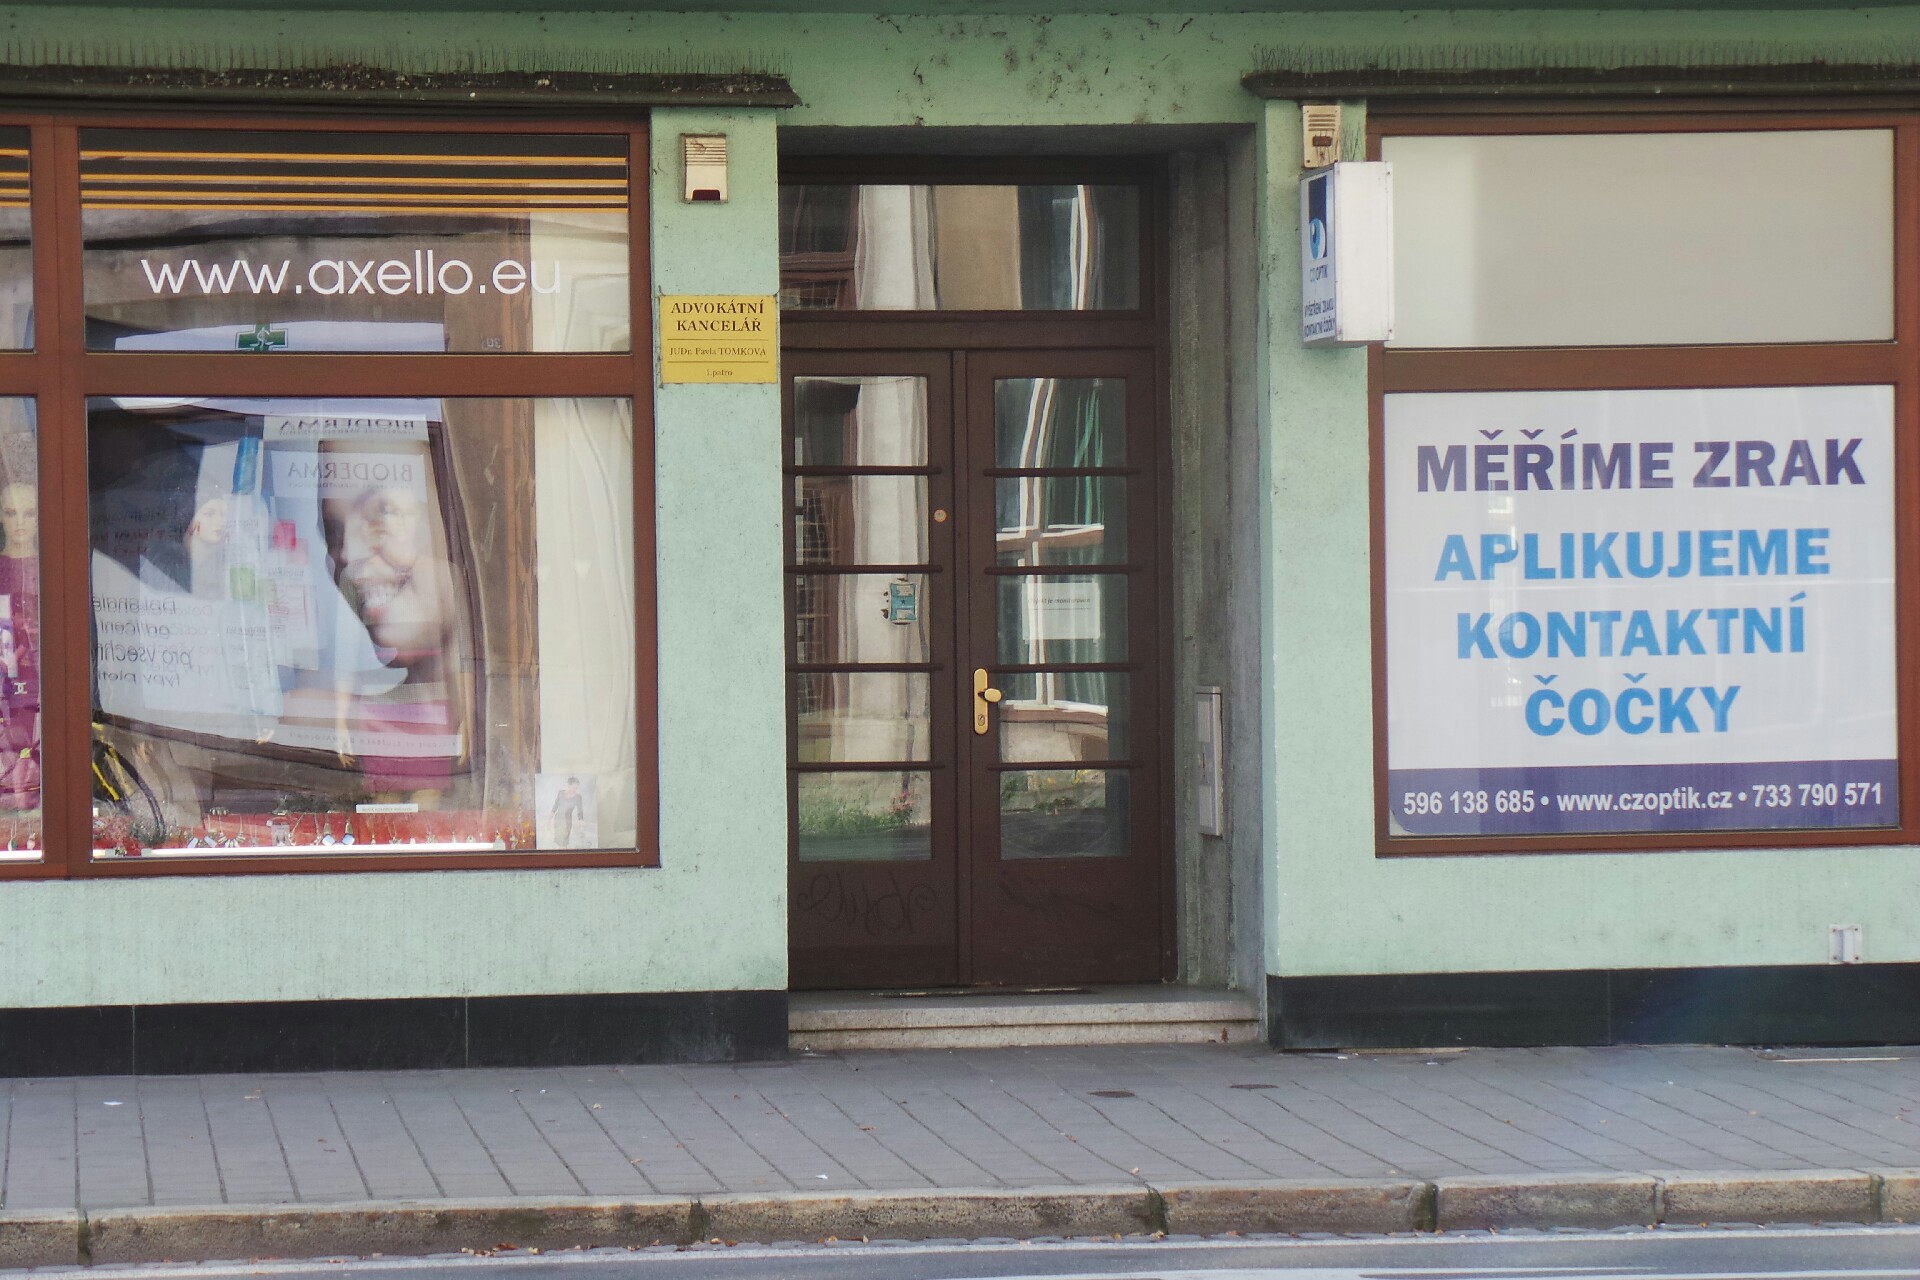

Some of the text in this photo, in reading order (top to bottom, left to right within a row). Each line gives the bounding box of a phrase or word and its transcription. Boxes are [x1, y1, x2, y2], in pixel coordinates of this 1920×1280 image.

[141, 249, 561, 296] www.axello.eu
[670, 299, 764, 314] ADVOKÁTNÍ
[677, 317, 762, 332] KANCELÁŘ
[695, 347, 717, 356] Pavla
[717, 344, 766, 357] TOMKOVÁ
[1417, 427, 1866, 493] MĚŘÍME ZRAK
[1434, 528, 1831, 581] APLIKUJEME
[1457, 591, 1808, 659] KONTAKTNÍ
[1524, 672, 1741, 737] ČOČKY
[1403, 782, 1882, 815] 596 138 685 www.czoptik.cz 733 790 571
